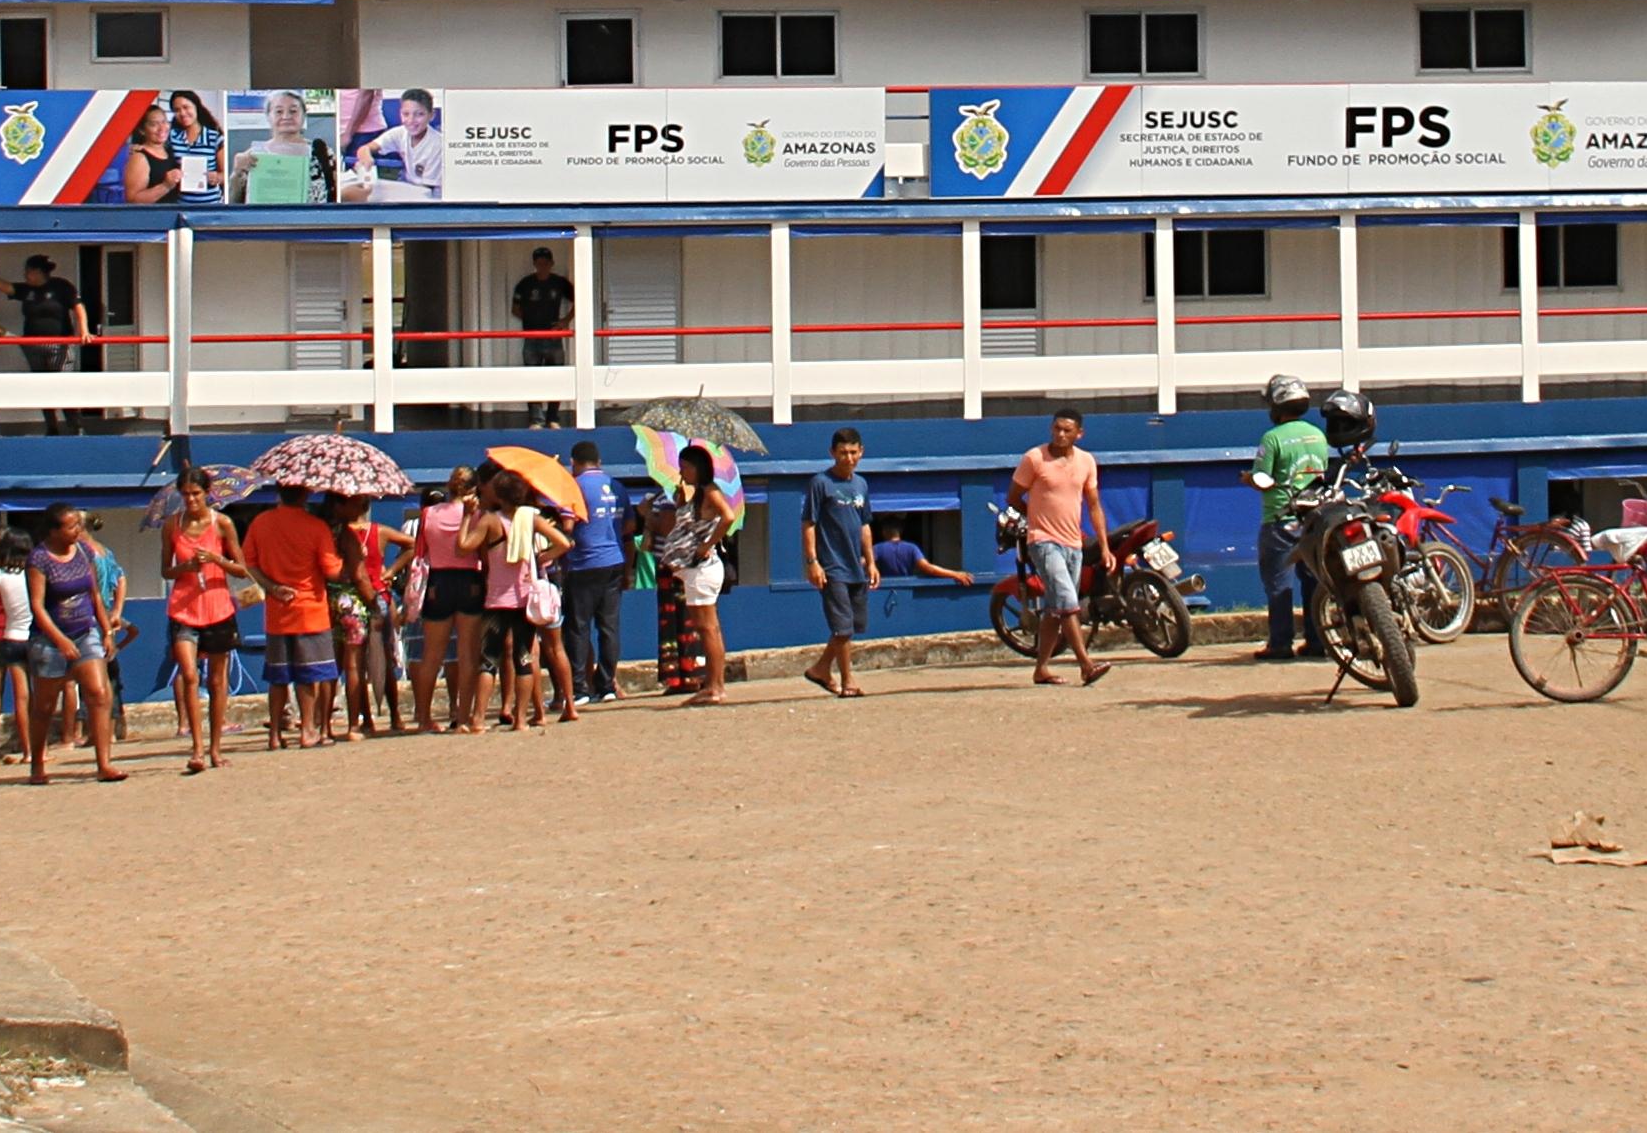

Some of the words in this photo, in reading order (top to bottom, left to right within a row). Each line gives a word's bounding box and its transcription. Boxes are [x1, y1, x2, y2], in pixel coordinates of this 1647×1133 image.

[1145, 110, 1238, 129] SEJUSC
[1585, 116, 1635, 126] GOVERNO
[1345, 105, 1451, 148] FPS
[465, 127, 532, 139] SEJUSC
[608, 124, 685, 153] FPS
[1120, 133, 1184, 142] SECRETARIA
[1187, 133, 1201, 141] DE
[1204, 132, 1246, 141] ESTADO
[1248, 132, 1262, 141] DE
[783, 142, 876, 154] AMAZONAS
[1143, 145, 1189, 155] JUSTIÇA,
[1192, 145, 1240, 154] DIREITOS
[567, 157, 603, 165] FUNDO
[606, 157, 619, 165] DE
[625, 155, 685, 166] PROMOÇÃO
[688, 156, 725, 165] SOCIAL
[784, 158, 819, 167] Governo
[820, 158, 835, 167] das
[837, 158, 870, 167] Pessoas
[1129, 158, 1182, 167] HUMANOS
[1186, 158, 1192, 166] E
[1195, 157, 1253, 166] CIDADANIA
[1288, 155, 1338, 166] FUNDO
[1342, 155, 1360, 165] DE
[1369, 151, 1451, 166] PROMOÇÃO
[1455, 153, 1506, 165] SOCIAL
[1587, 155, 1635, 168] Governo
